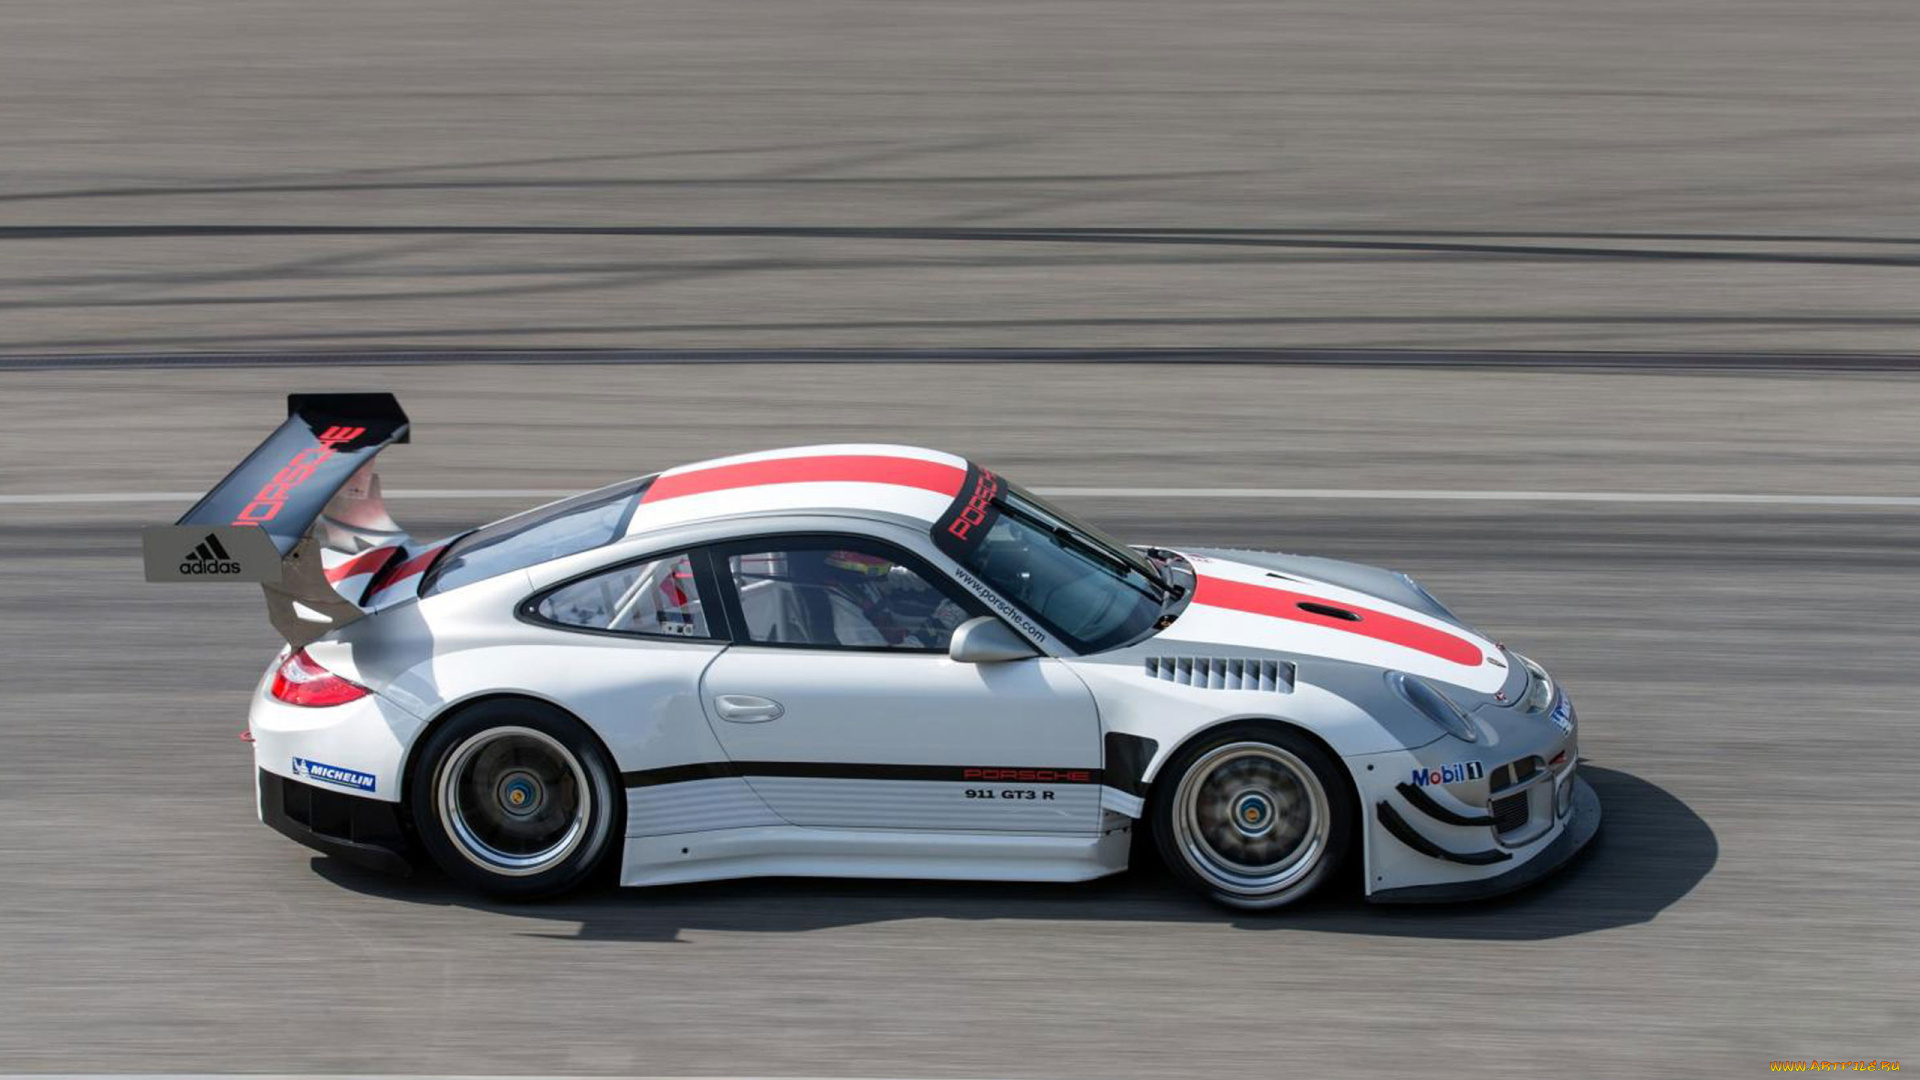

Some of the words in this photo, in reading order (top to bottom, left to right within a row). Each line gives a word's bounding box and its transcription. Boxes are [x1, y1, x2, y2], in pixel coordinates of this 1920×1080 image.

[231, 426, 366, 526] ORSCHE
[949, 468, 998, 540] PORSC
[180, 557, 241, 574] adidas
[954, 567, 1046, 643] www.porsche.com
[310, 765, 373, 786] MICHELIN
[964, 769, 1089, 781] PORSCHE
[1412, 763, 1465, 786] Mobil
[1470, 762, 1482, 779] 1
[965, 789, 995, 800] 911
[1001, 790, 1036, 800] GT3
[1042, 791, 1055, 800] R
